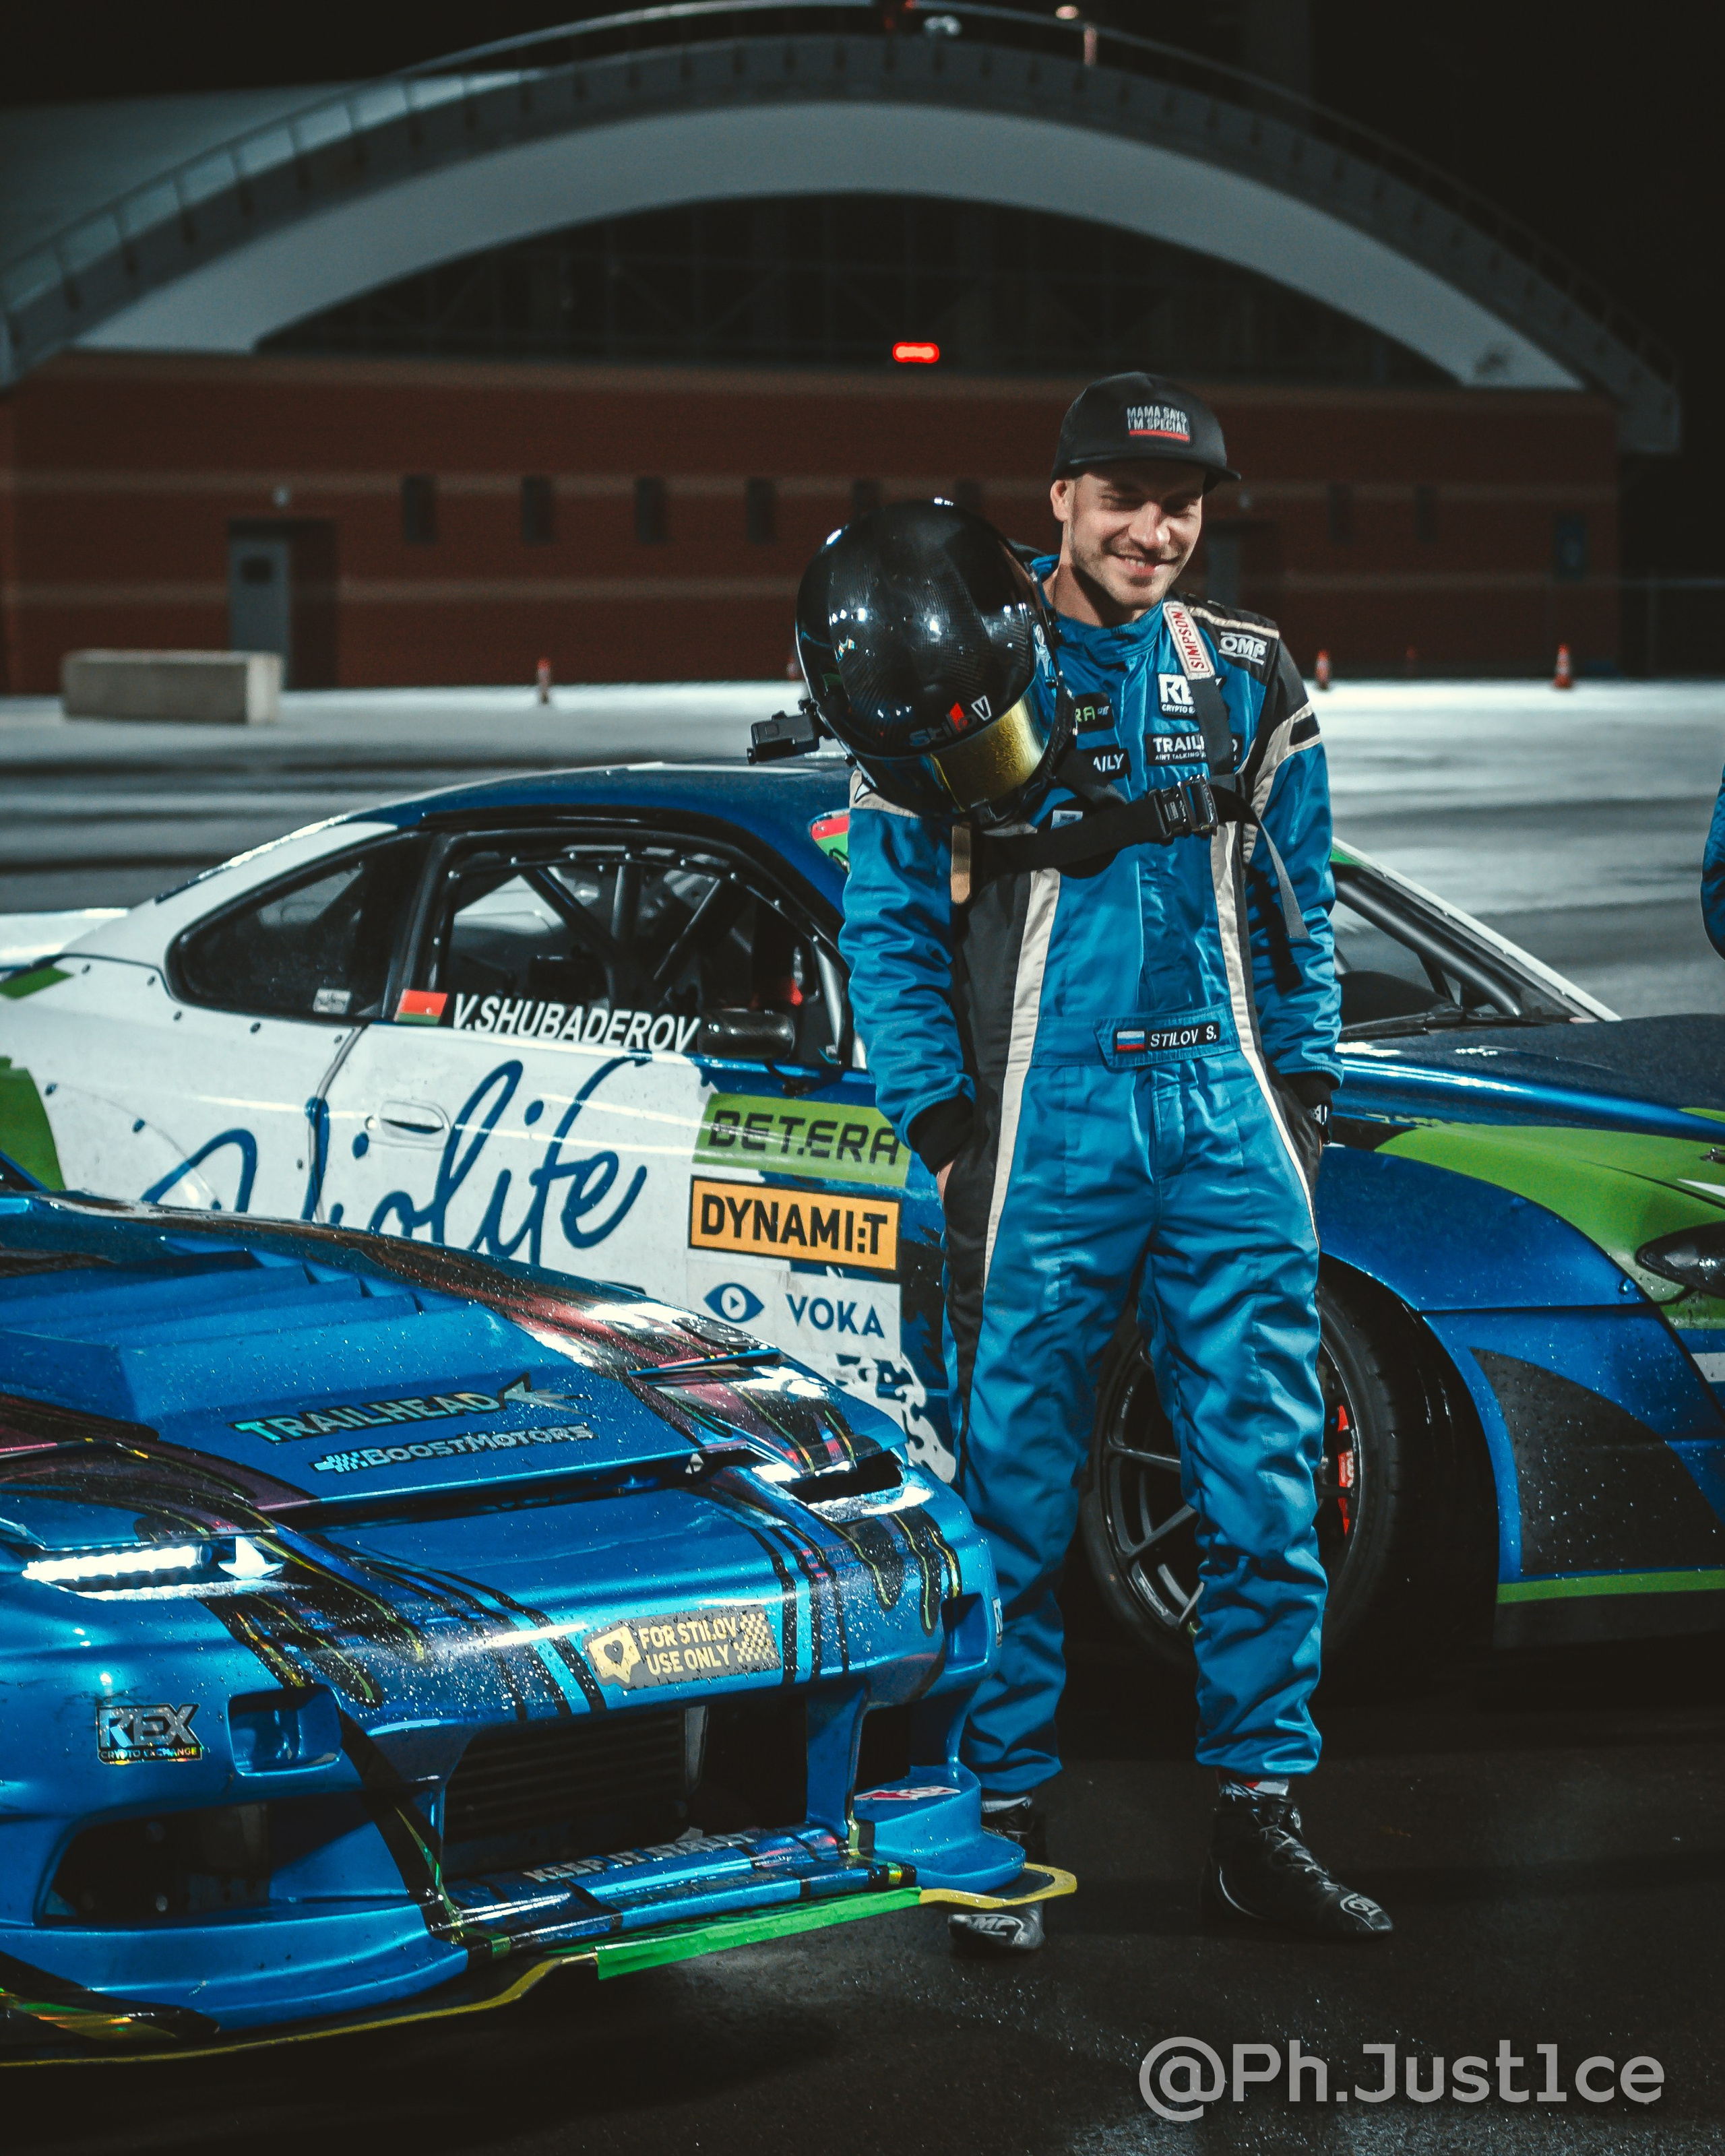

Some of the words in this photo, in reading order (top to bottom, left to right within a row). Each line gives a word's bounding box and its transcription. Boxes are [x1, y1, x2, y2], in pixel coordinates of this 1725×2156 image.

[1127, 406, 1160, 418] MAMA
[1147, 416, 1189, 435] SPECIAL
[1172, 611, 1204, 669] SIMPSON
[1220, 635, 1266, 660] OMP
[1161, 703, 1188, 714] CRYPTO
[453, 992, 701, 1053] V.SHUBADEROV
[1150, 1027, 1199, 1048] STILOV
[1206, 1025, 1217, 1040] S.
[708, 1109, 900, 1166] BET.ERA
[701, 1193, 888, 1255] DYNAMI:T
[785, 1293, 885, 1339] VOKA
[234, 1392, 502, 1442] TRAILHEAD
[638, 1624, 677, 1649] FOR
[677, 1616, 737, 1645] STILOV
[645, 1649, 683, 1676] USE
[684, 1644, 730, 1670] ONLY
[99, 1705, 199, 1749] REX
[100, 1748, 141, 1760] CRYPTO
[522, 1858, 604, 1883] KEEP
